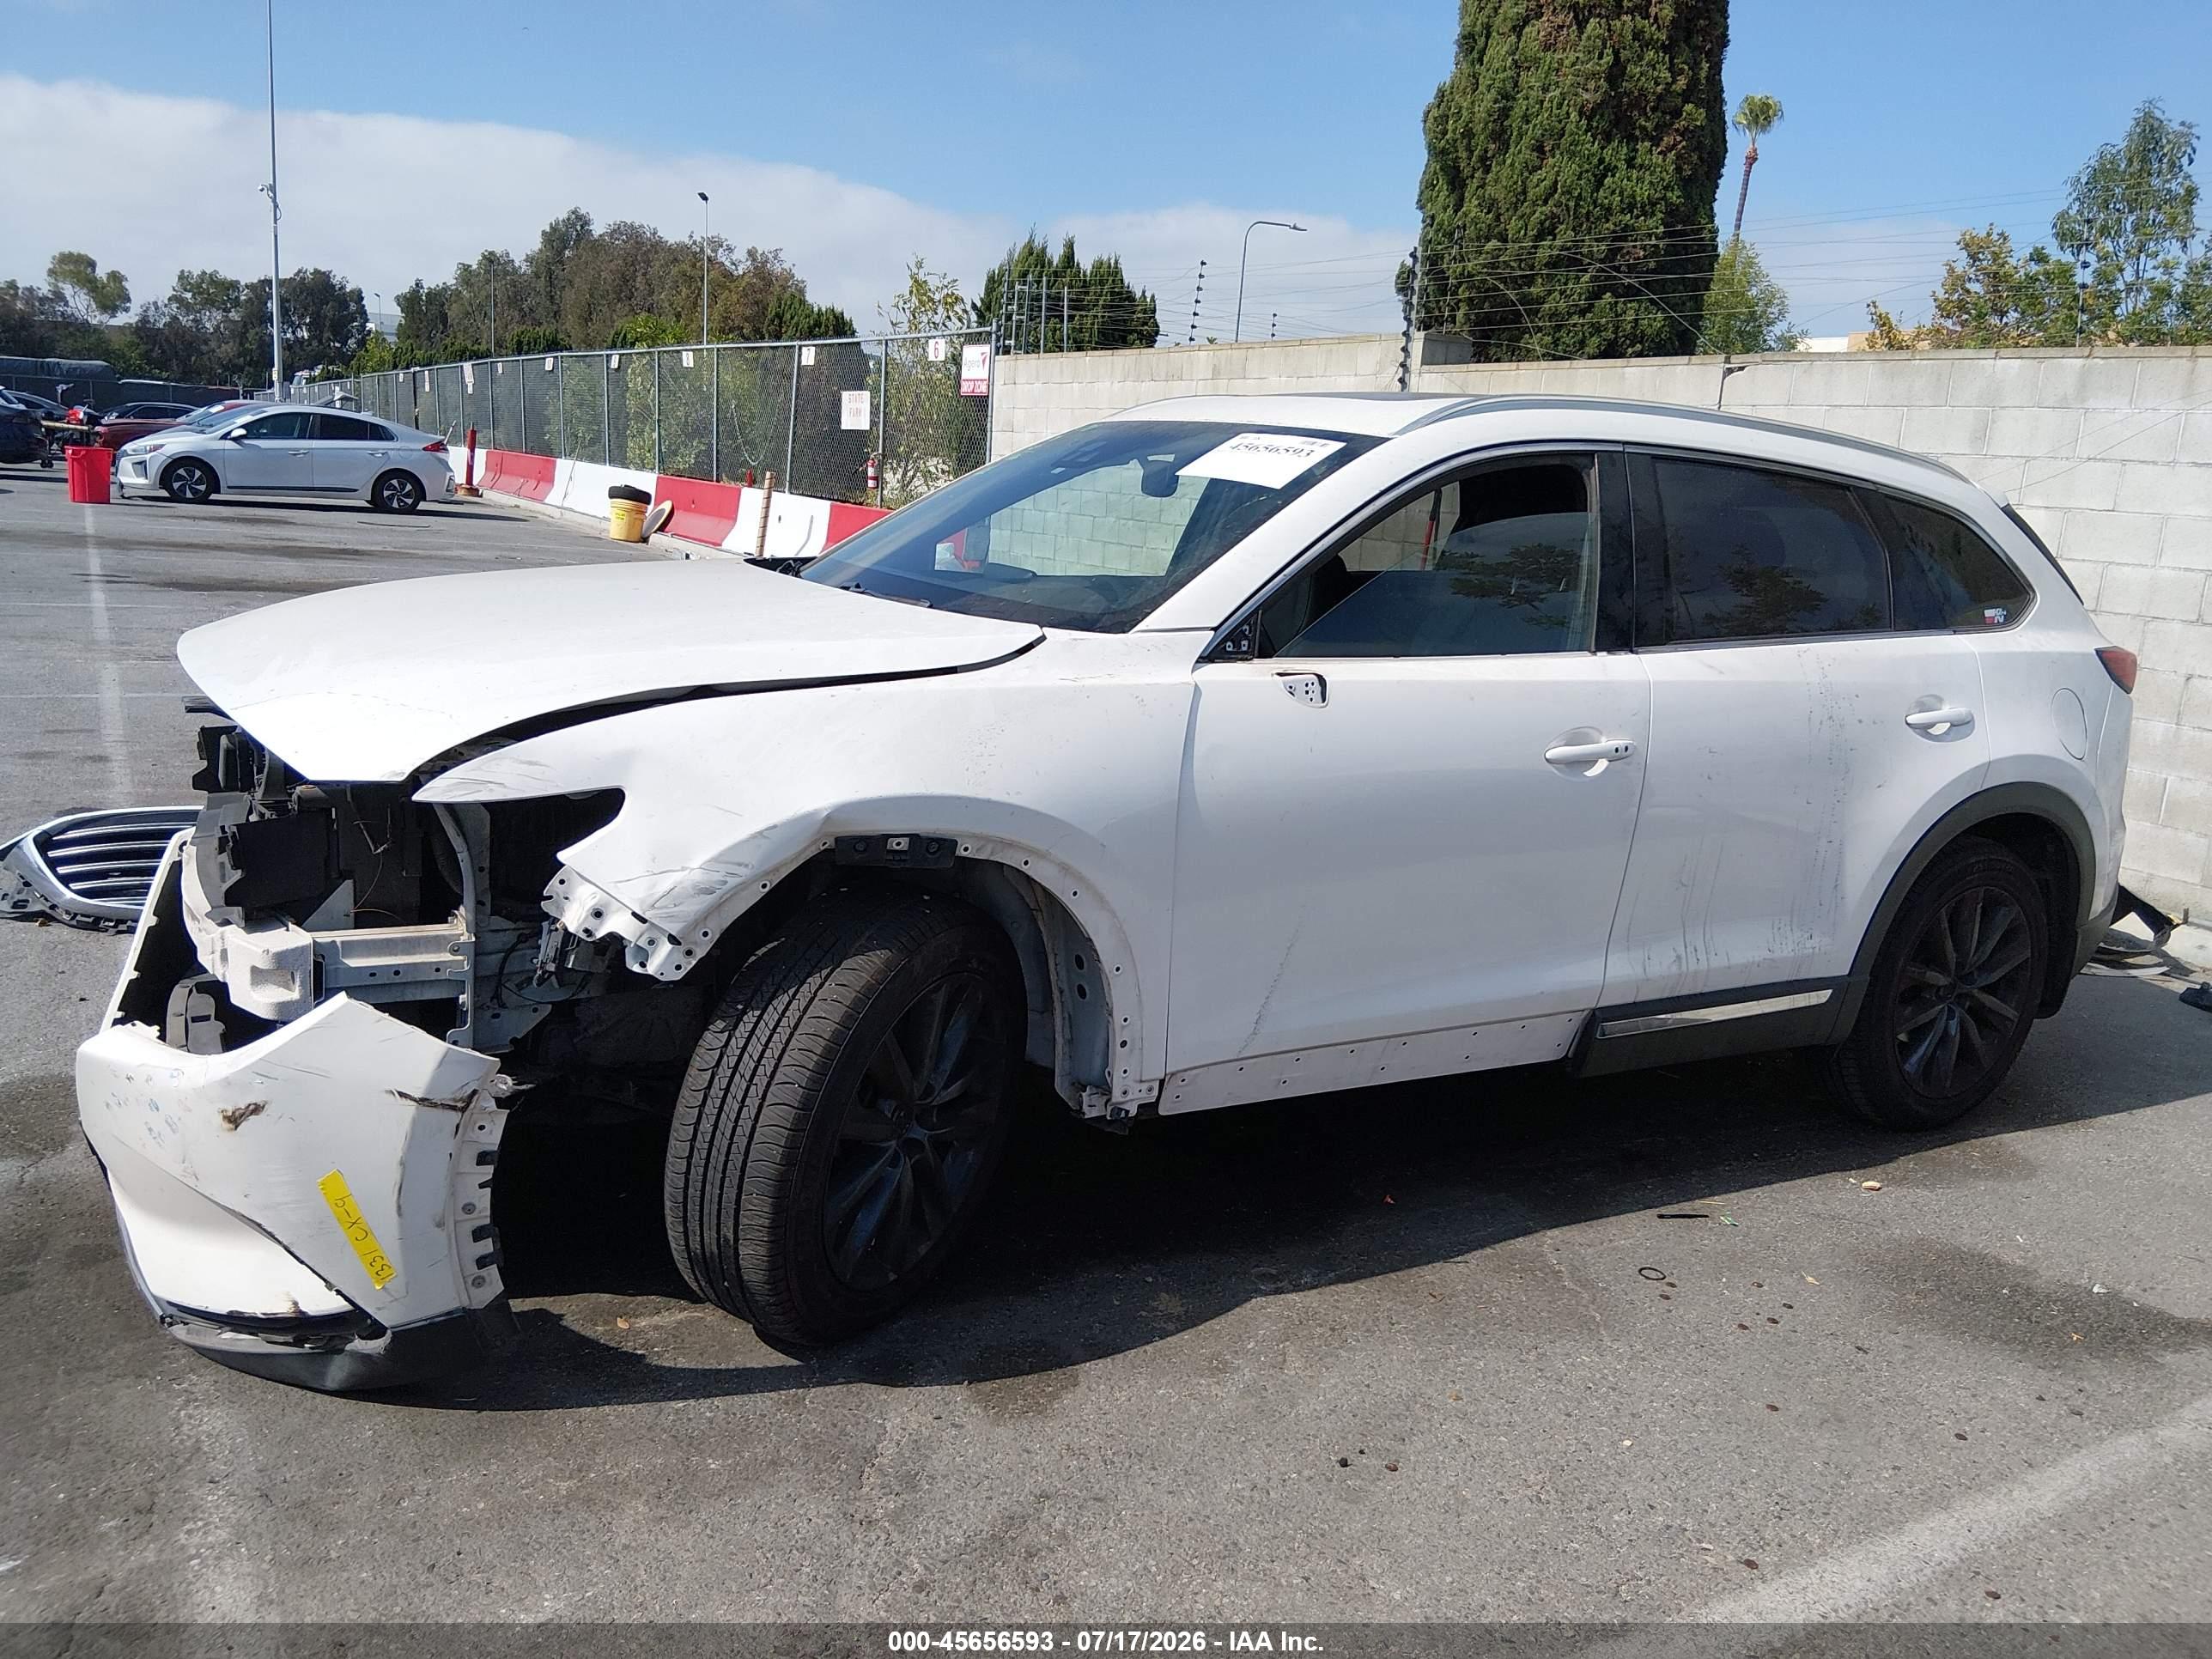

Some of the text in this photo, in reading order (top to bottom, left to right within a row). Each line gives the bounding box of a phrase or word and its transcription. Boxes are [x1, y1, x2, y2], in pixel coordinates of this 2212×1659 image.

[806, 348, 811, 364] 7
[933, 341, 939, 359] 6
[962, 380, 975, 393] DROP
